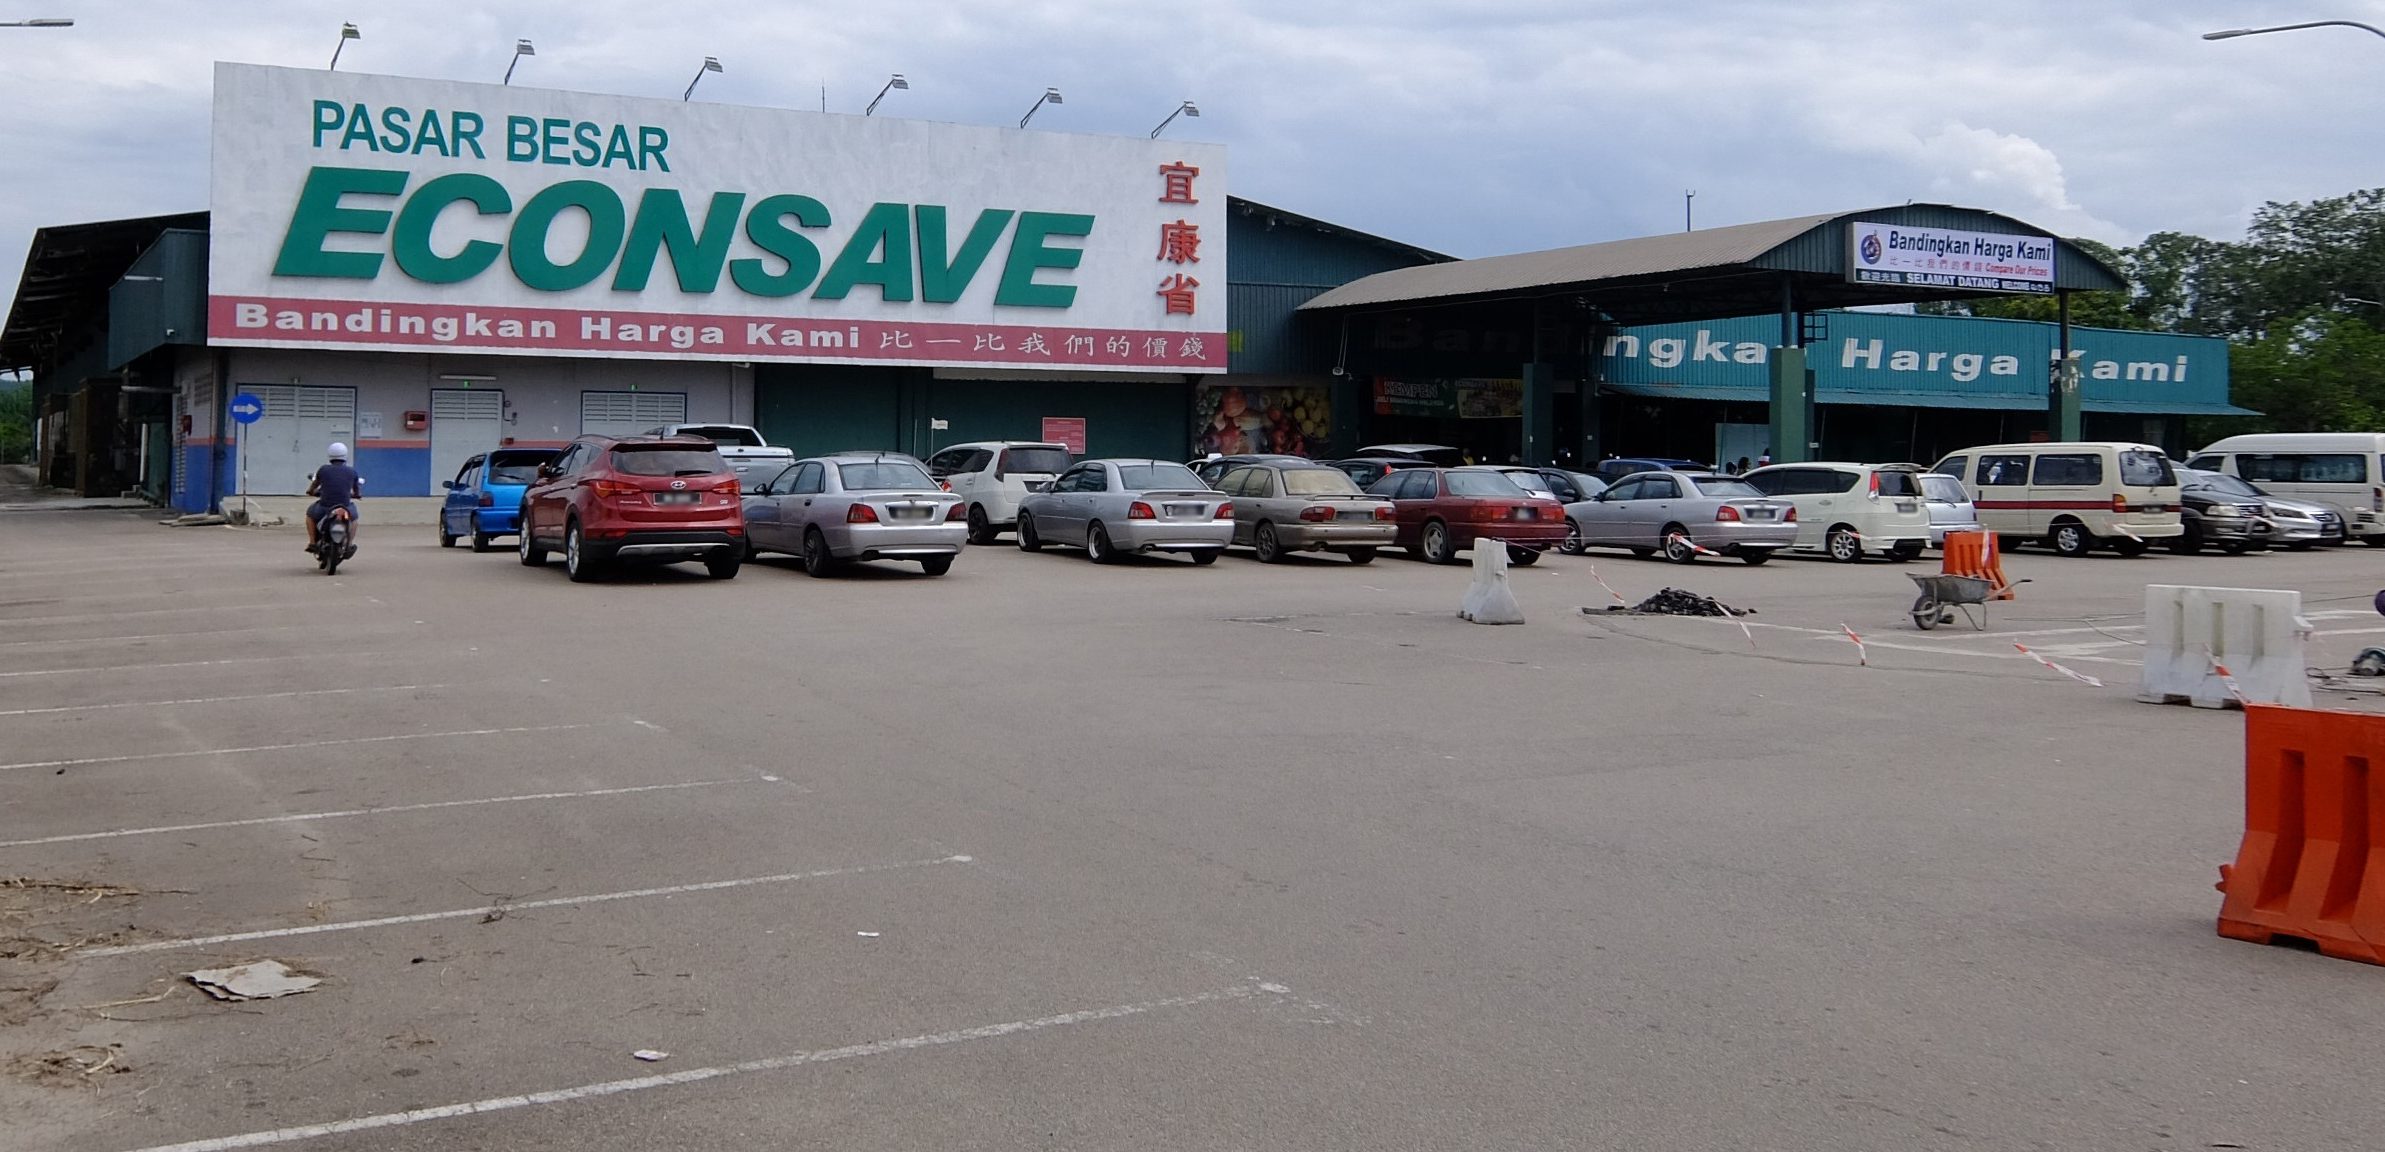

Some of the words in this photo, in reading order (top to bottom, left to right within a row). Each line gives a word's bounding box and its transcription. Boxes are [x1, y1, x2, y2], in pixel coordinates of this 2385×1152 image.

[313, 100, 485, 159] PASAR
[507, 115, 670, 172] BESAR
[271, 166, 1095, 308] ECONSAVE
[1157, 161, 1201, 316] 宜康省
[1889, 230, 1970, 257] Bandingkan
[1974, 237, 2012, 262] Harga
[2017, 241, 2051, 261] Kami
[1907, 272, 1955, 286] SELAMAT
[1958, 276, 1999, 289] DATANG
[235, 303, 556, 342] Bandingkan
[582, 317, 725, 349] Harga
[747, 322, 860, 349] Kami
[880, 330, 1206, 360] 比一比我們的價錢
[1842, 338, 2018, 382] Harga
